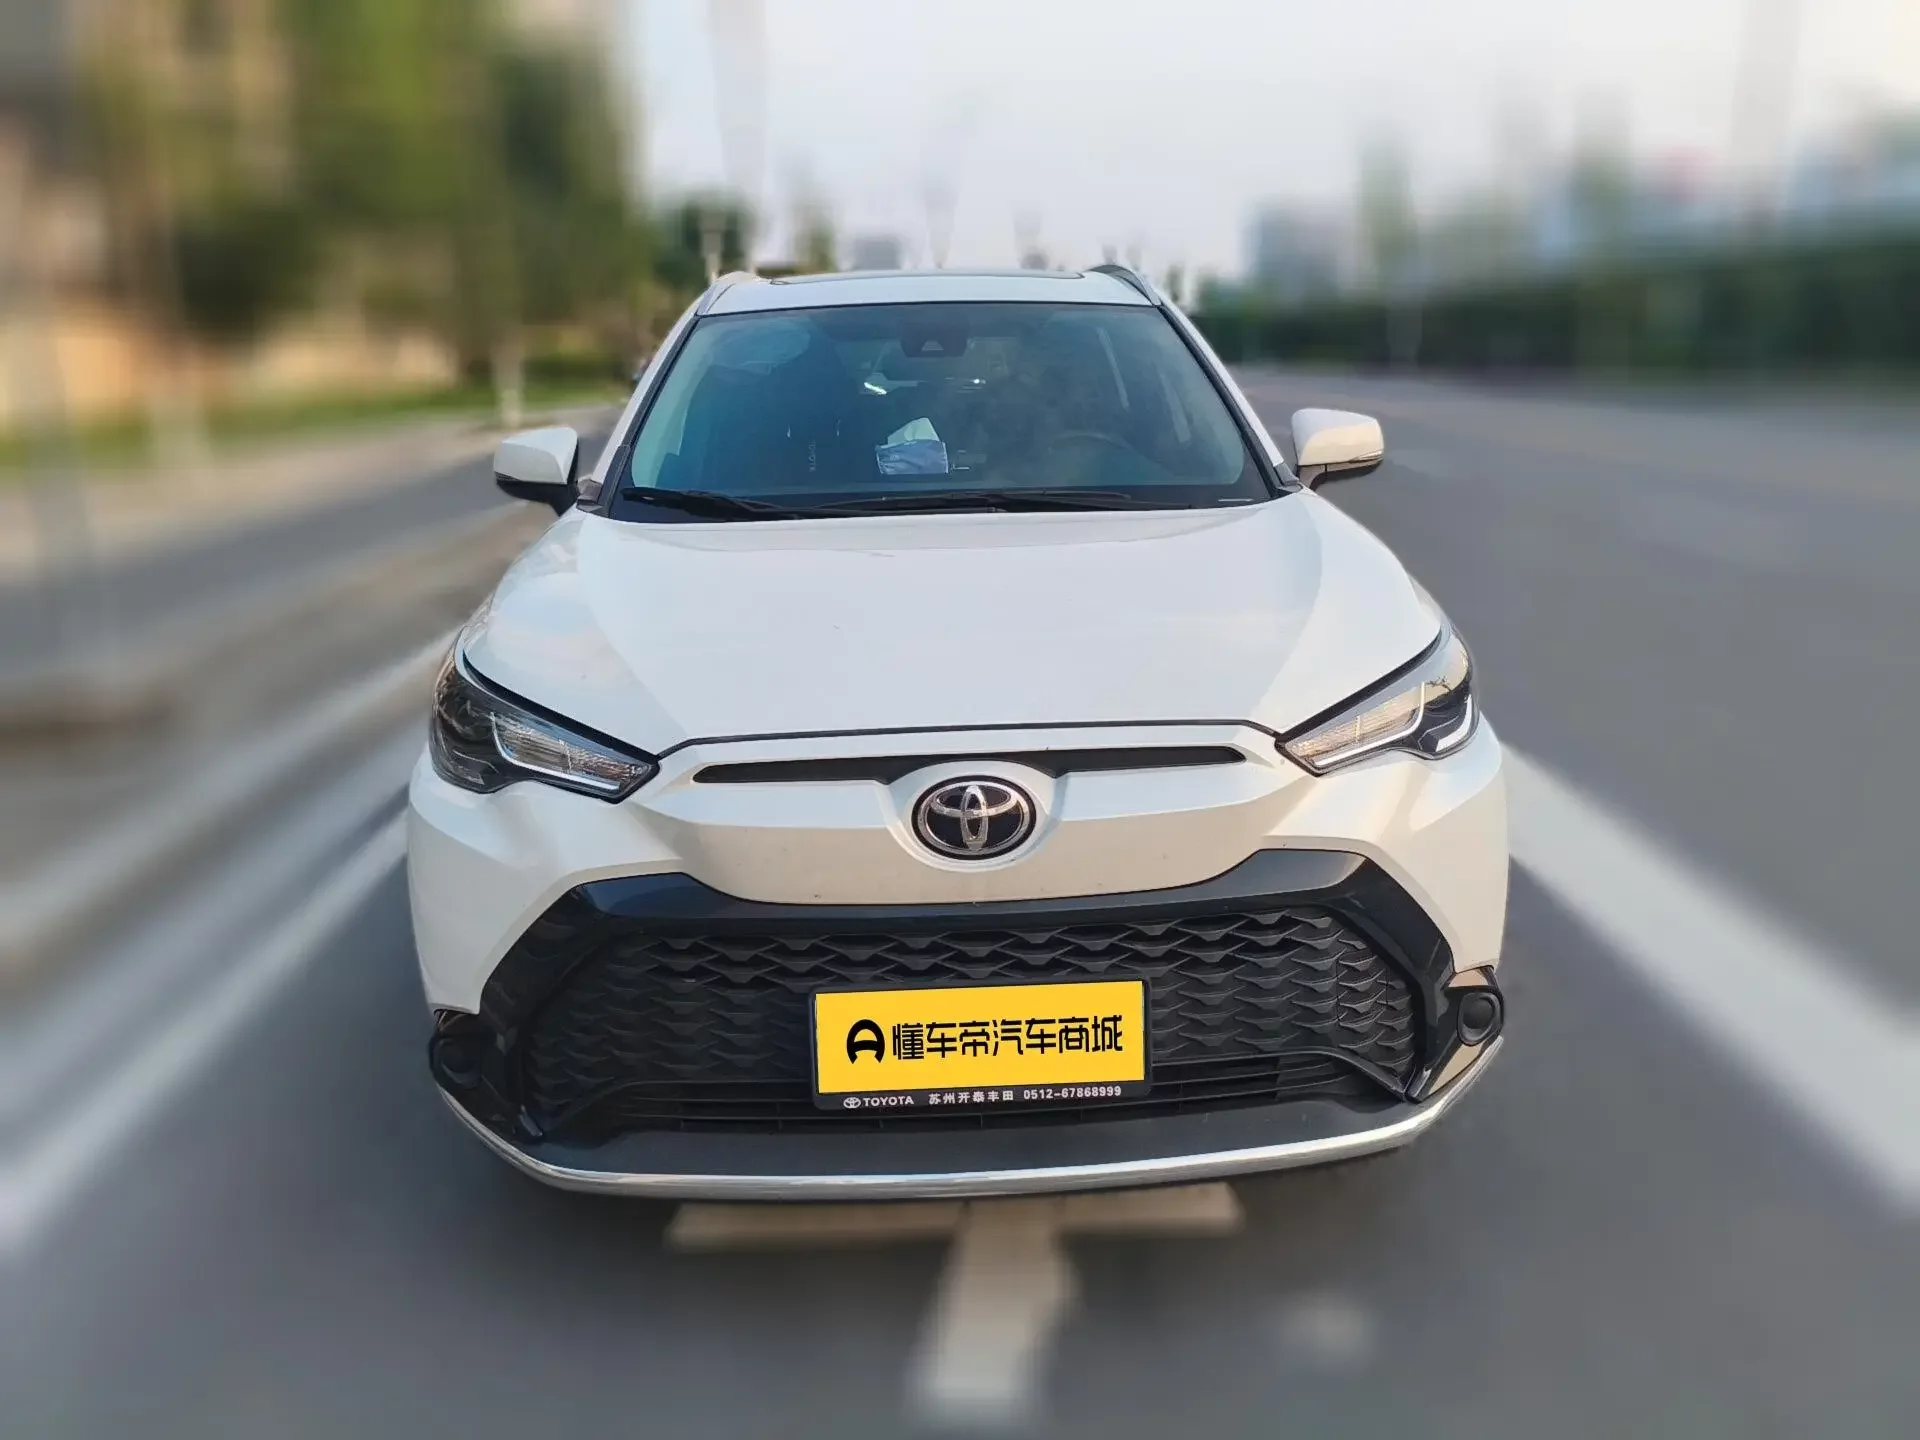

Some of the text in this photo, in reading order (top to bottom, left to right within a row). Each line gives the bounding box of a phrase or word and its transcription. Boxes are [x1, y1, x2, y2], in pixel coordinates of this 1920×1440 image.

[863, 1085, 1122, 1107] TOYOTA 苏州开泰丰田 0512-67868999
